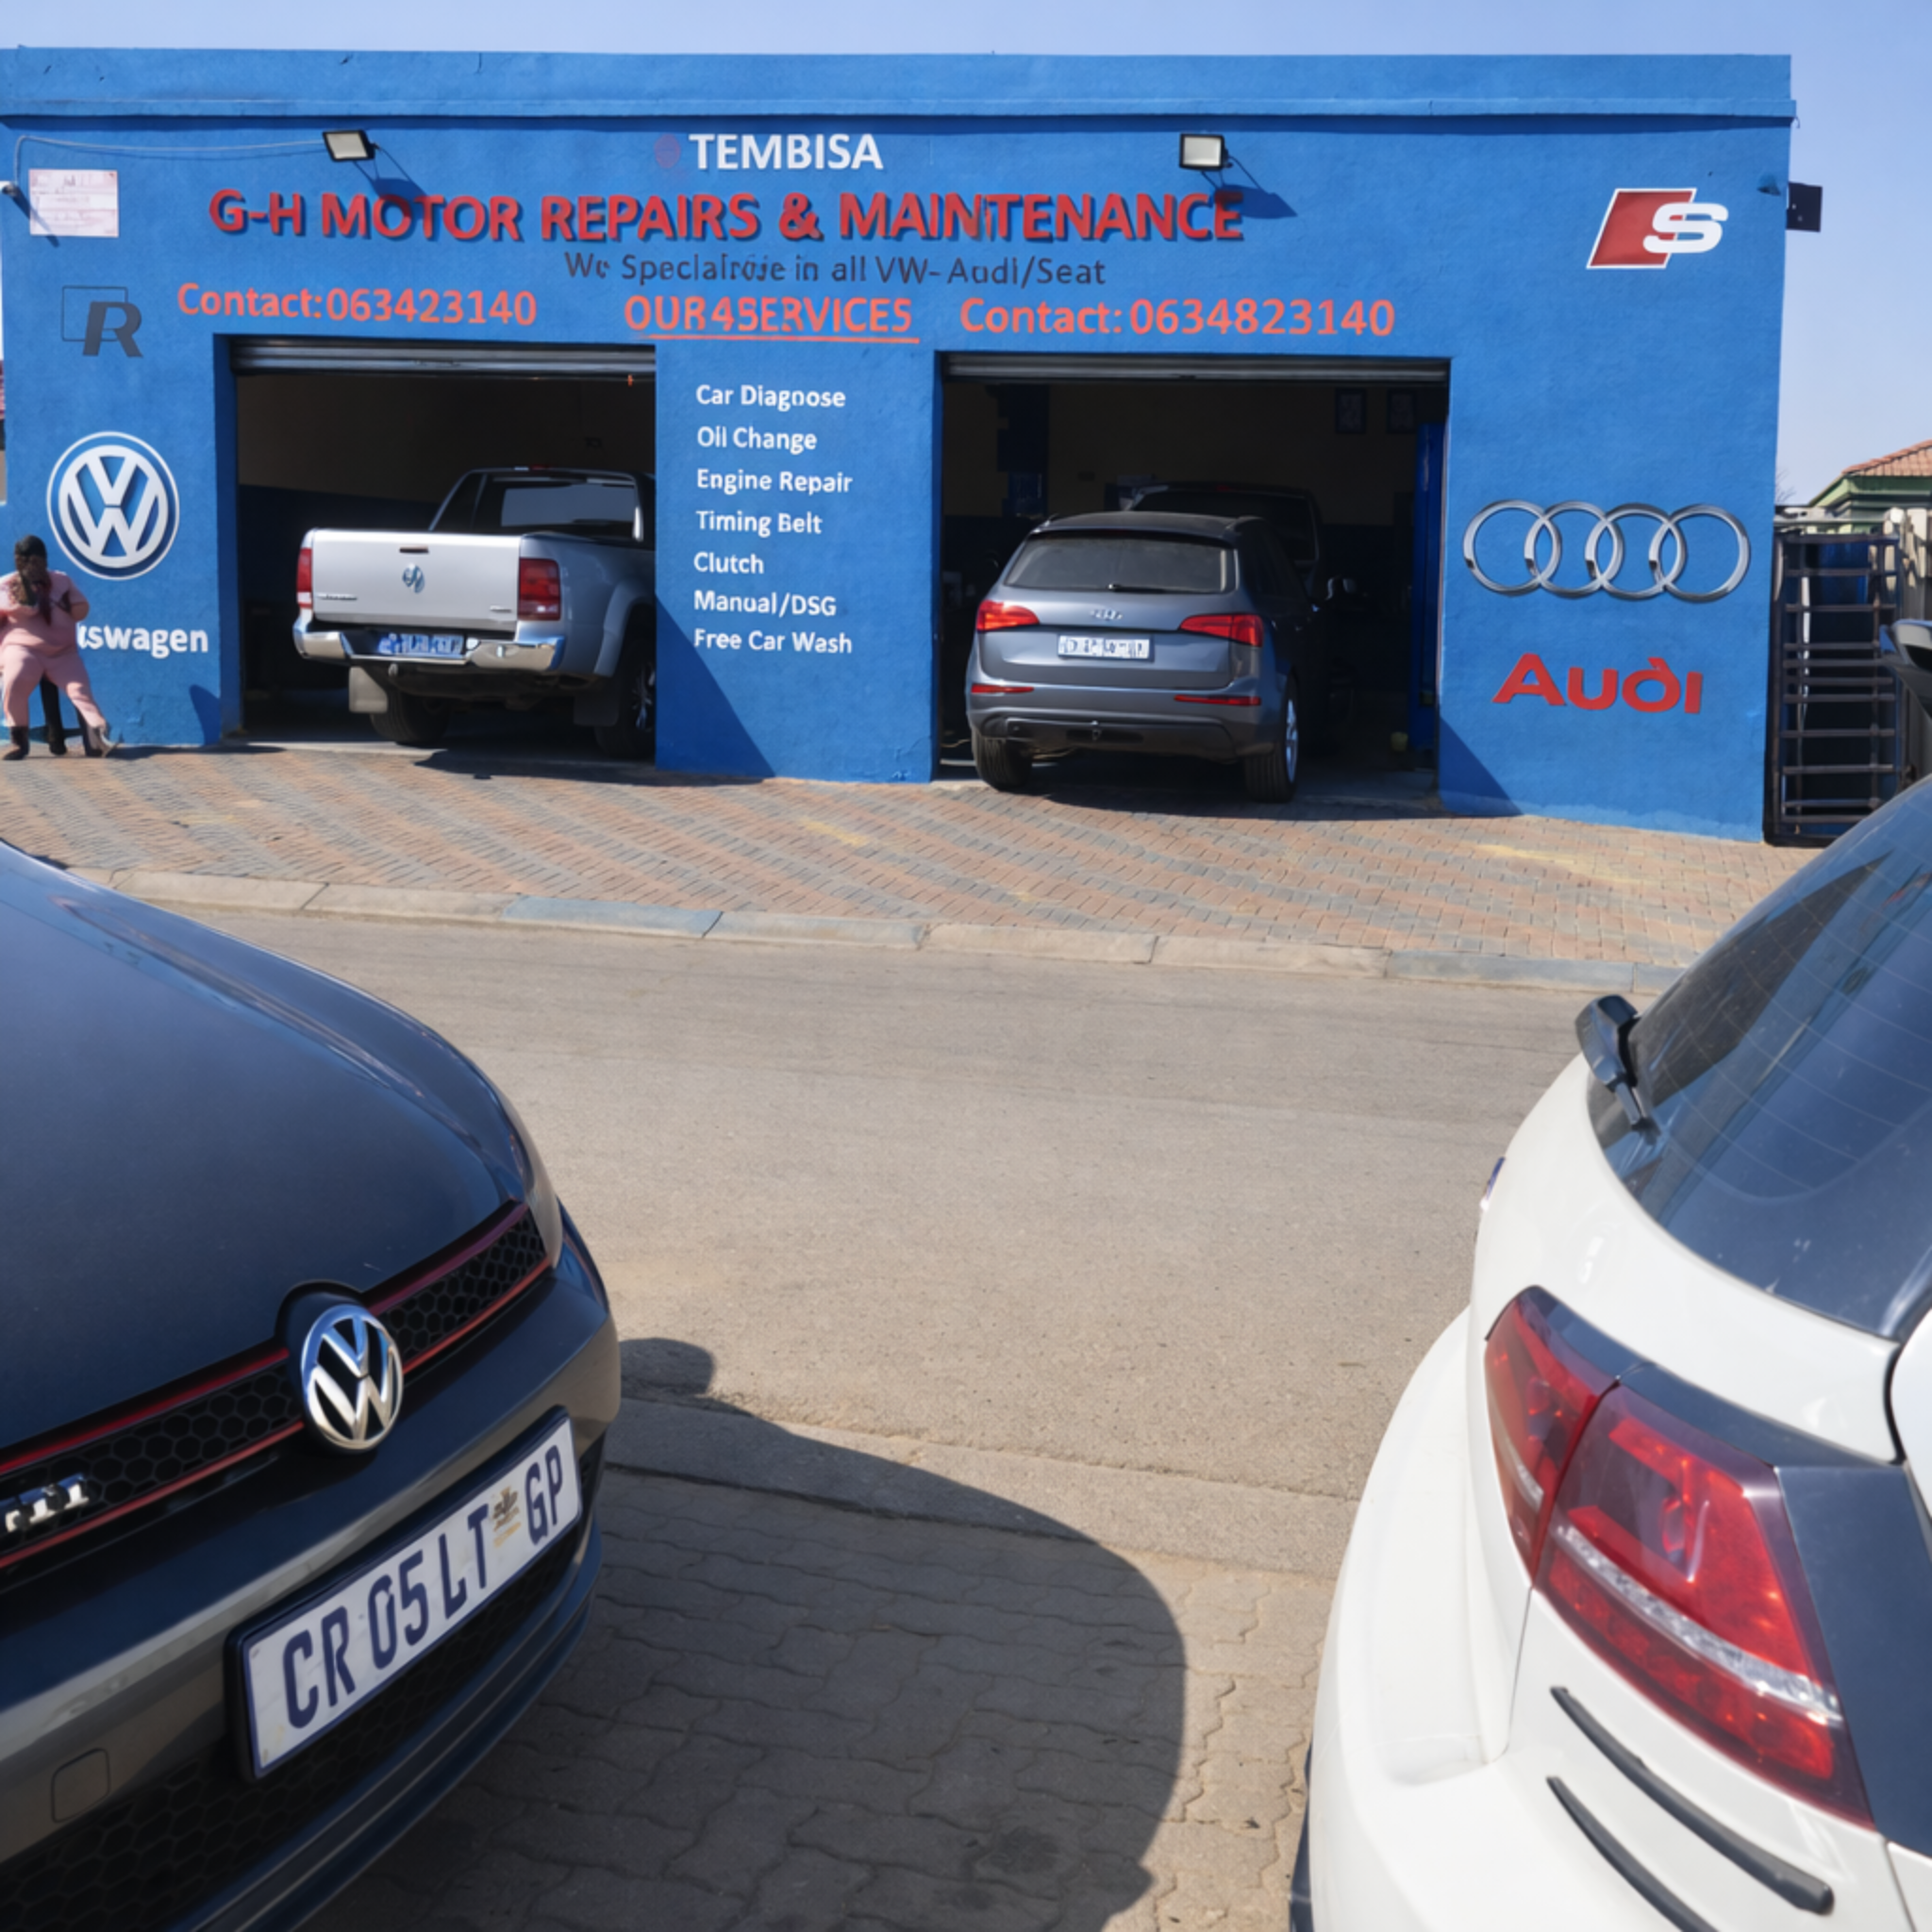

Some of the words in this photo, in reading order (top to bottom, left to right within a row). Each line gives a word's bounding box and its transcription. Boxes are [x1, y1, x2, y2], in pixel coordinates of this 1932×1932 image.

[688, 133, 884, 170] TEMBISA
[208, 188, 302, 235] G-H
[321, 192, 522, 242] MOTOR
[541, 192, 760, 242] REPAIRS
[778, 192, 823, 241] &
[840, 192, 1242, 241] MAINTENANCE
[795, 255, 820, 282] in
[831, 255, 867, 282] all
[696, 384, 735, 406] Car
[741, 384, 847, 412] Diagnose
[697, 425, 727, 449] Oil
[733, 426, 818, 456] Change
[697, 468, 773, 496] Engine
[779, 471, 854, 495] Repair
[695, 510, 773, 538] Timing
[777, 512, 824, 535] Belt
[693, 551, 765, 575] Clutch
[693, 590, 838, 618] Manual/DSG
[693, 628, 742, 651] Free
[748, 630, 786, 652] Car
[791, 631, 853, 655] Wash
[282, 1606, 358, 1729] CR
[438, 1502, 491, 1619] LT
[524, 1444, 565, 1546] GP
